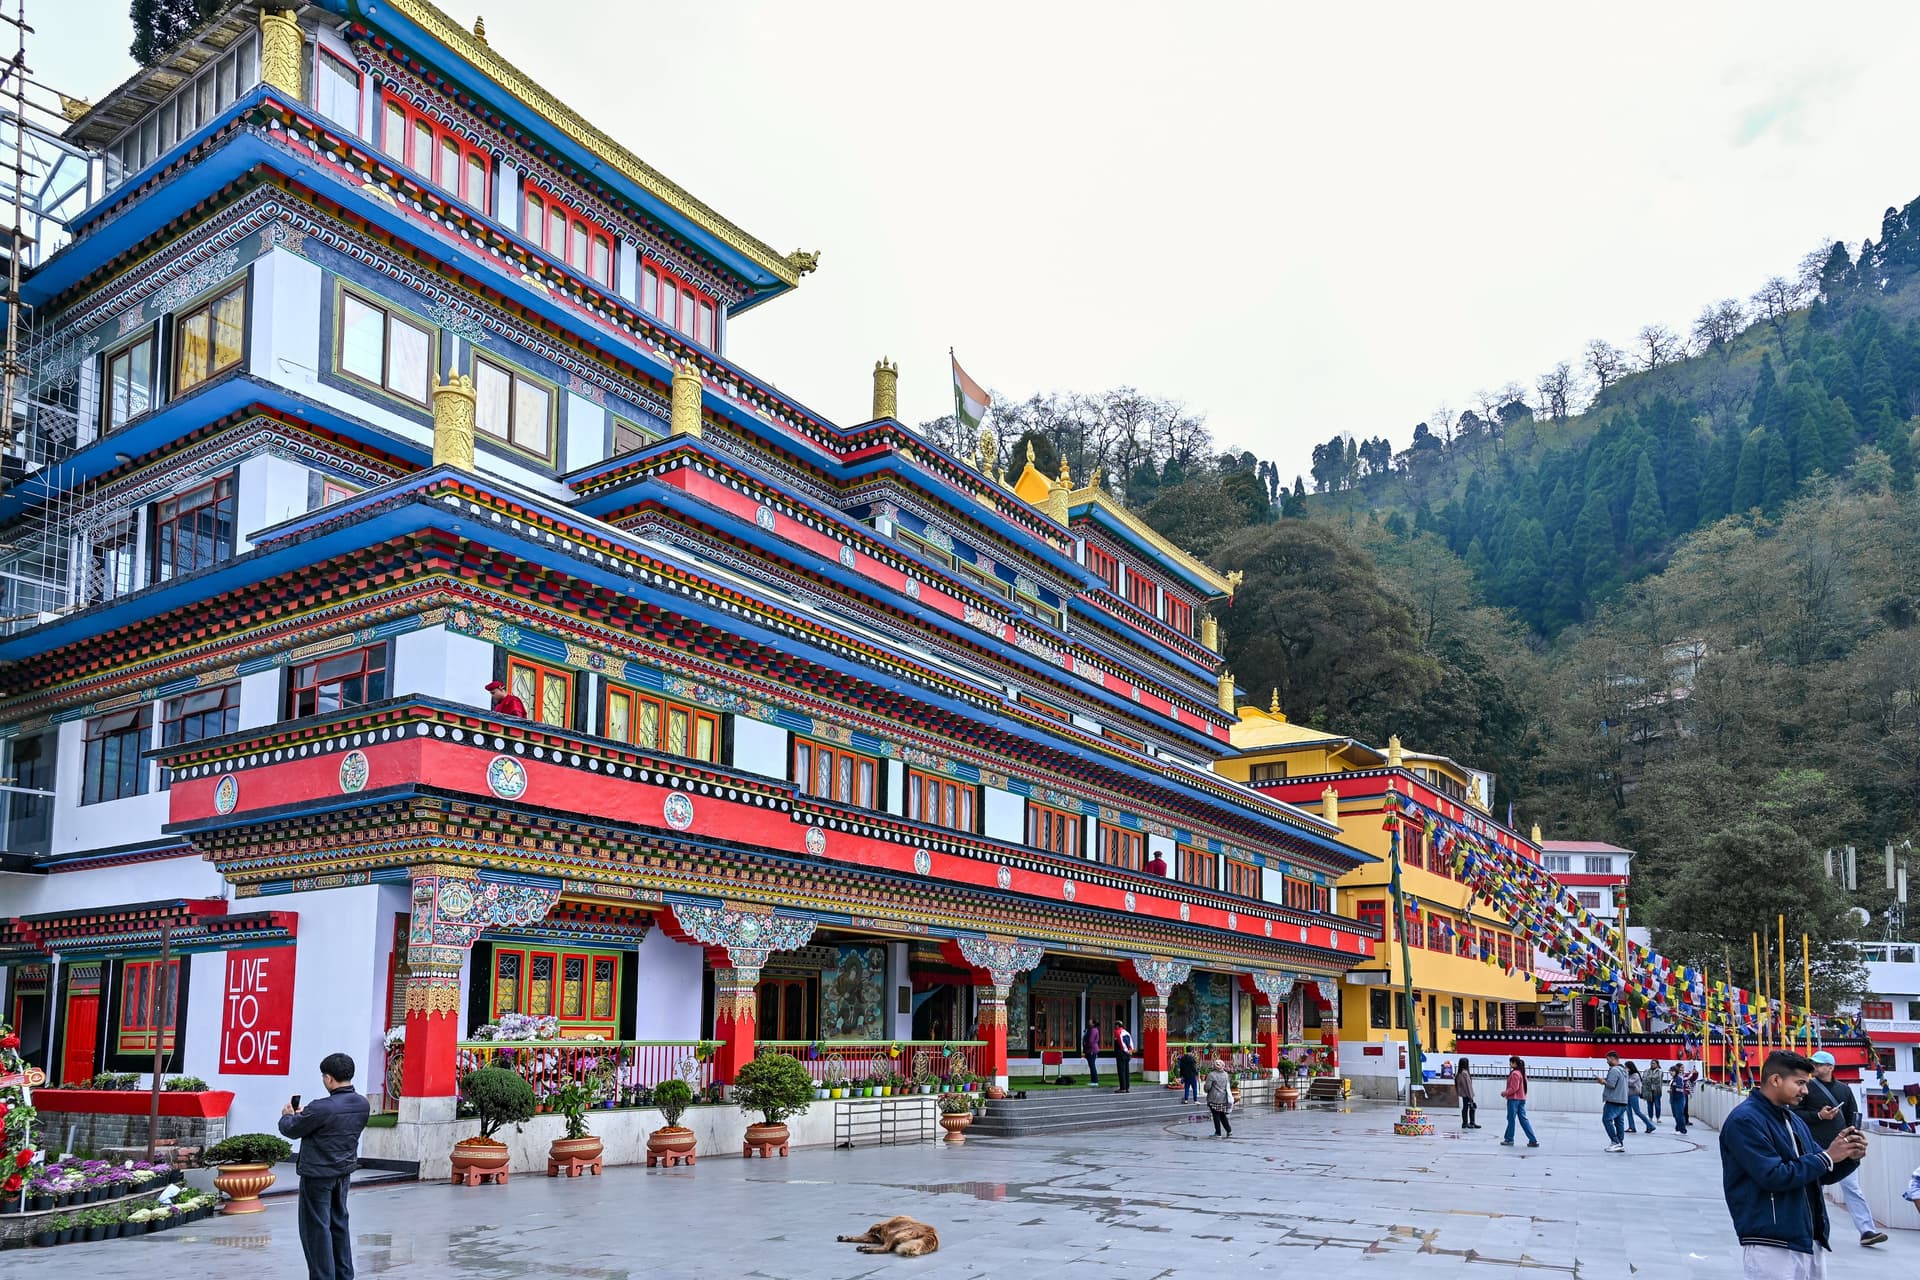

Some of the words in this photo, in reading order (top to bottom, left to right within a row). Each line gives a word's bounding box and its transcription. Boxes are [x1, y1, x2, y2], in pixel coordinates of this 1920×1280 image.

[229, 957, 270, 993] LIVE
[228, 994, 259, 1029] TO
[224, 1030, 281, 1065] LOVE
